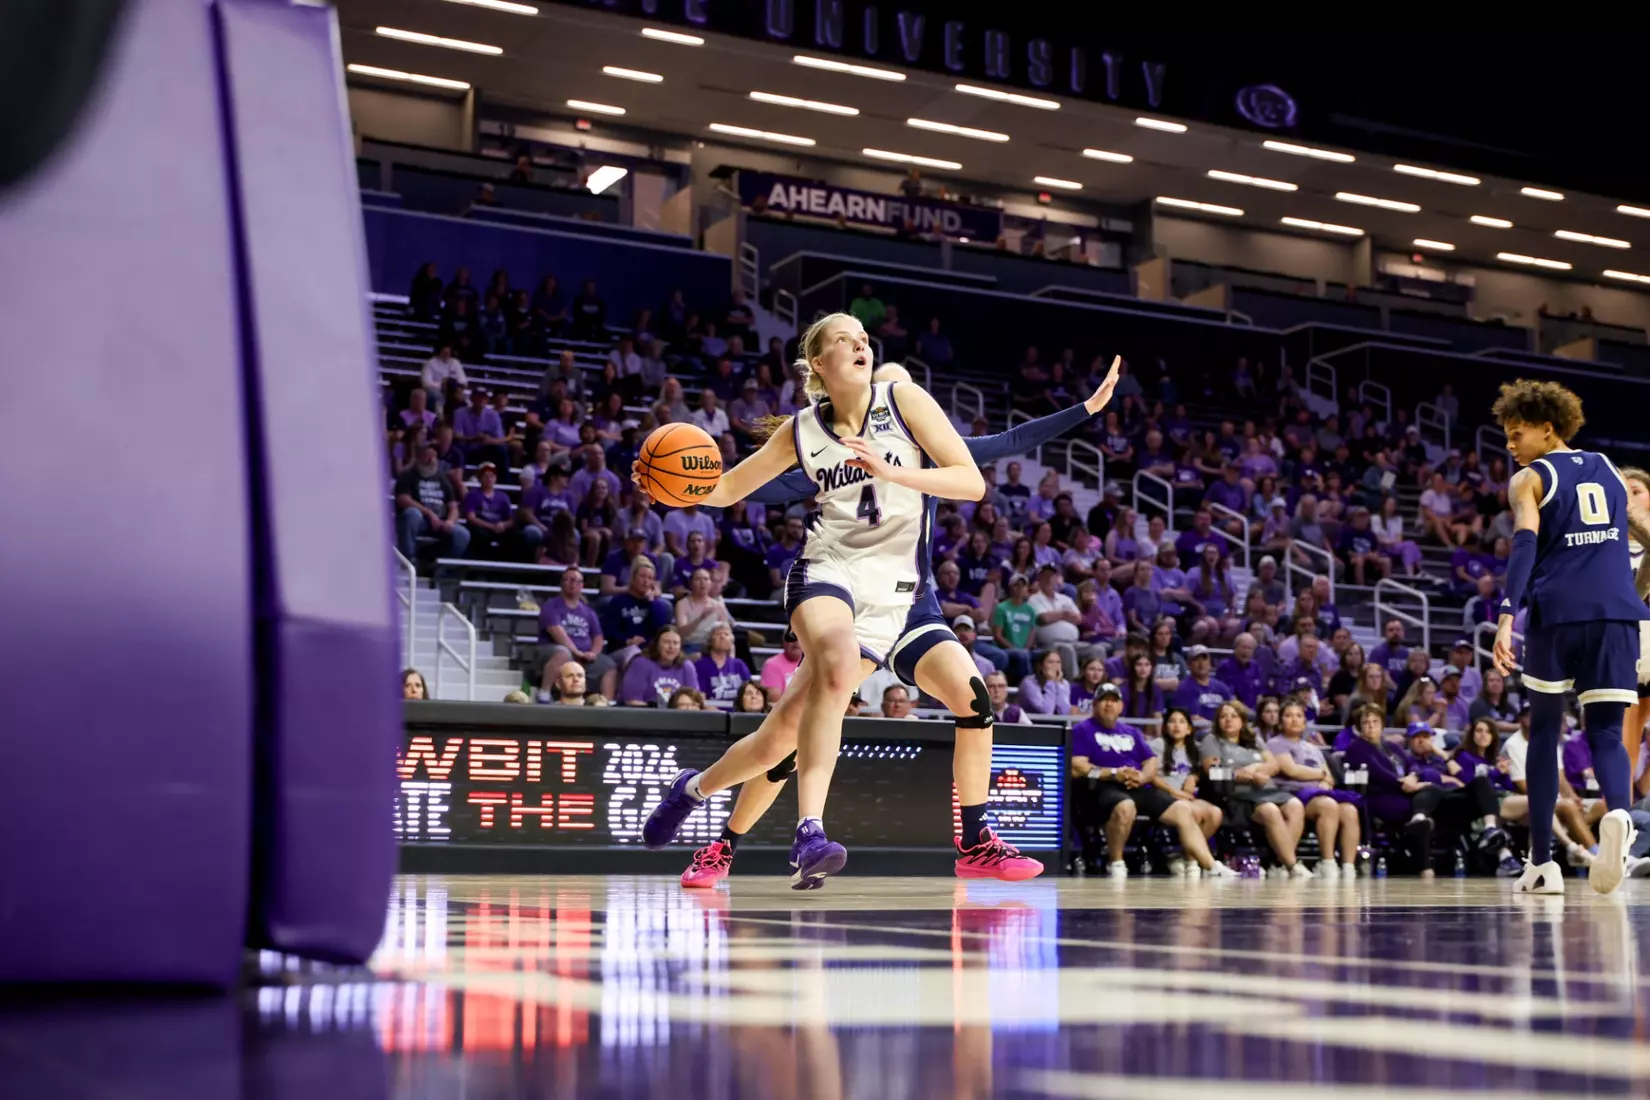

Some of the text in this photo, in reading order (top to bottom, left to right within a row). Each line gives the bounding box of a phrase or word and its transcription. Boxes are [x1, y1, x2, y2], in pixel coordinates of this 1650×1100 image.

[766, 0, 1165, 108] UNIVERSITY
[856, 483, 882, 528] 4
[1576, 482, 1610, 525] 0
[1564, 527, 1620, 547] TURNAGE
[393, 782, 452, 840] TE
[467, 791, 594, 828] THE
